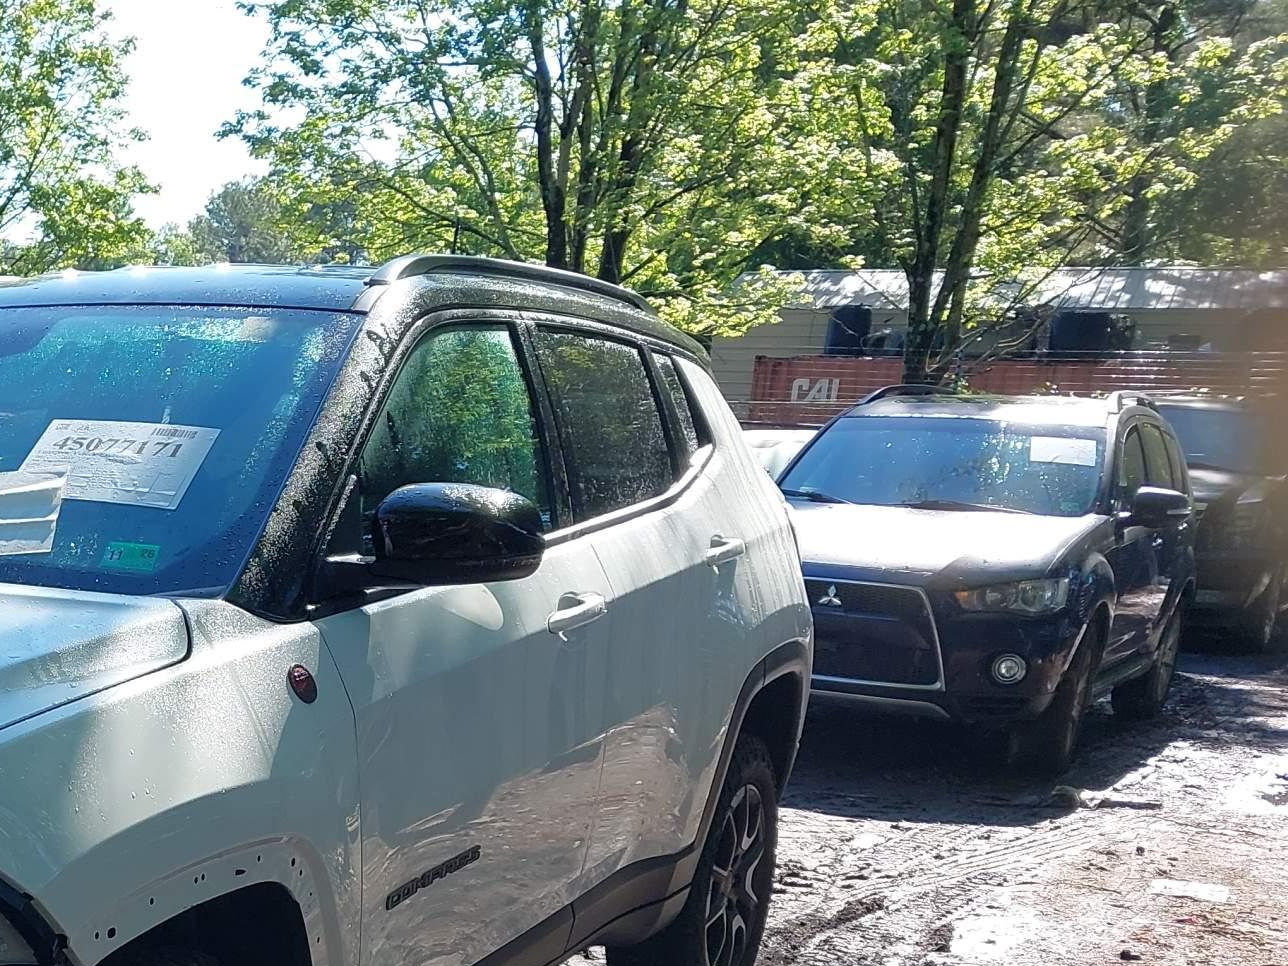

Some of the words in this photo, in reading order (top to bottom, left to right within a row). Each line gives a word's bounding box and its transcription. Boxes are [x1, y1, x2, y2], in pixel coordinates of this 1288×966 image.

[791, 378, 840, 401] CAI
[52, 436, 183, 458] 45077171
[385, 845, 481, 911] COMPASS
